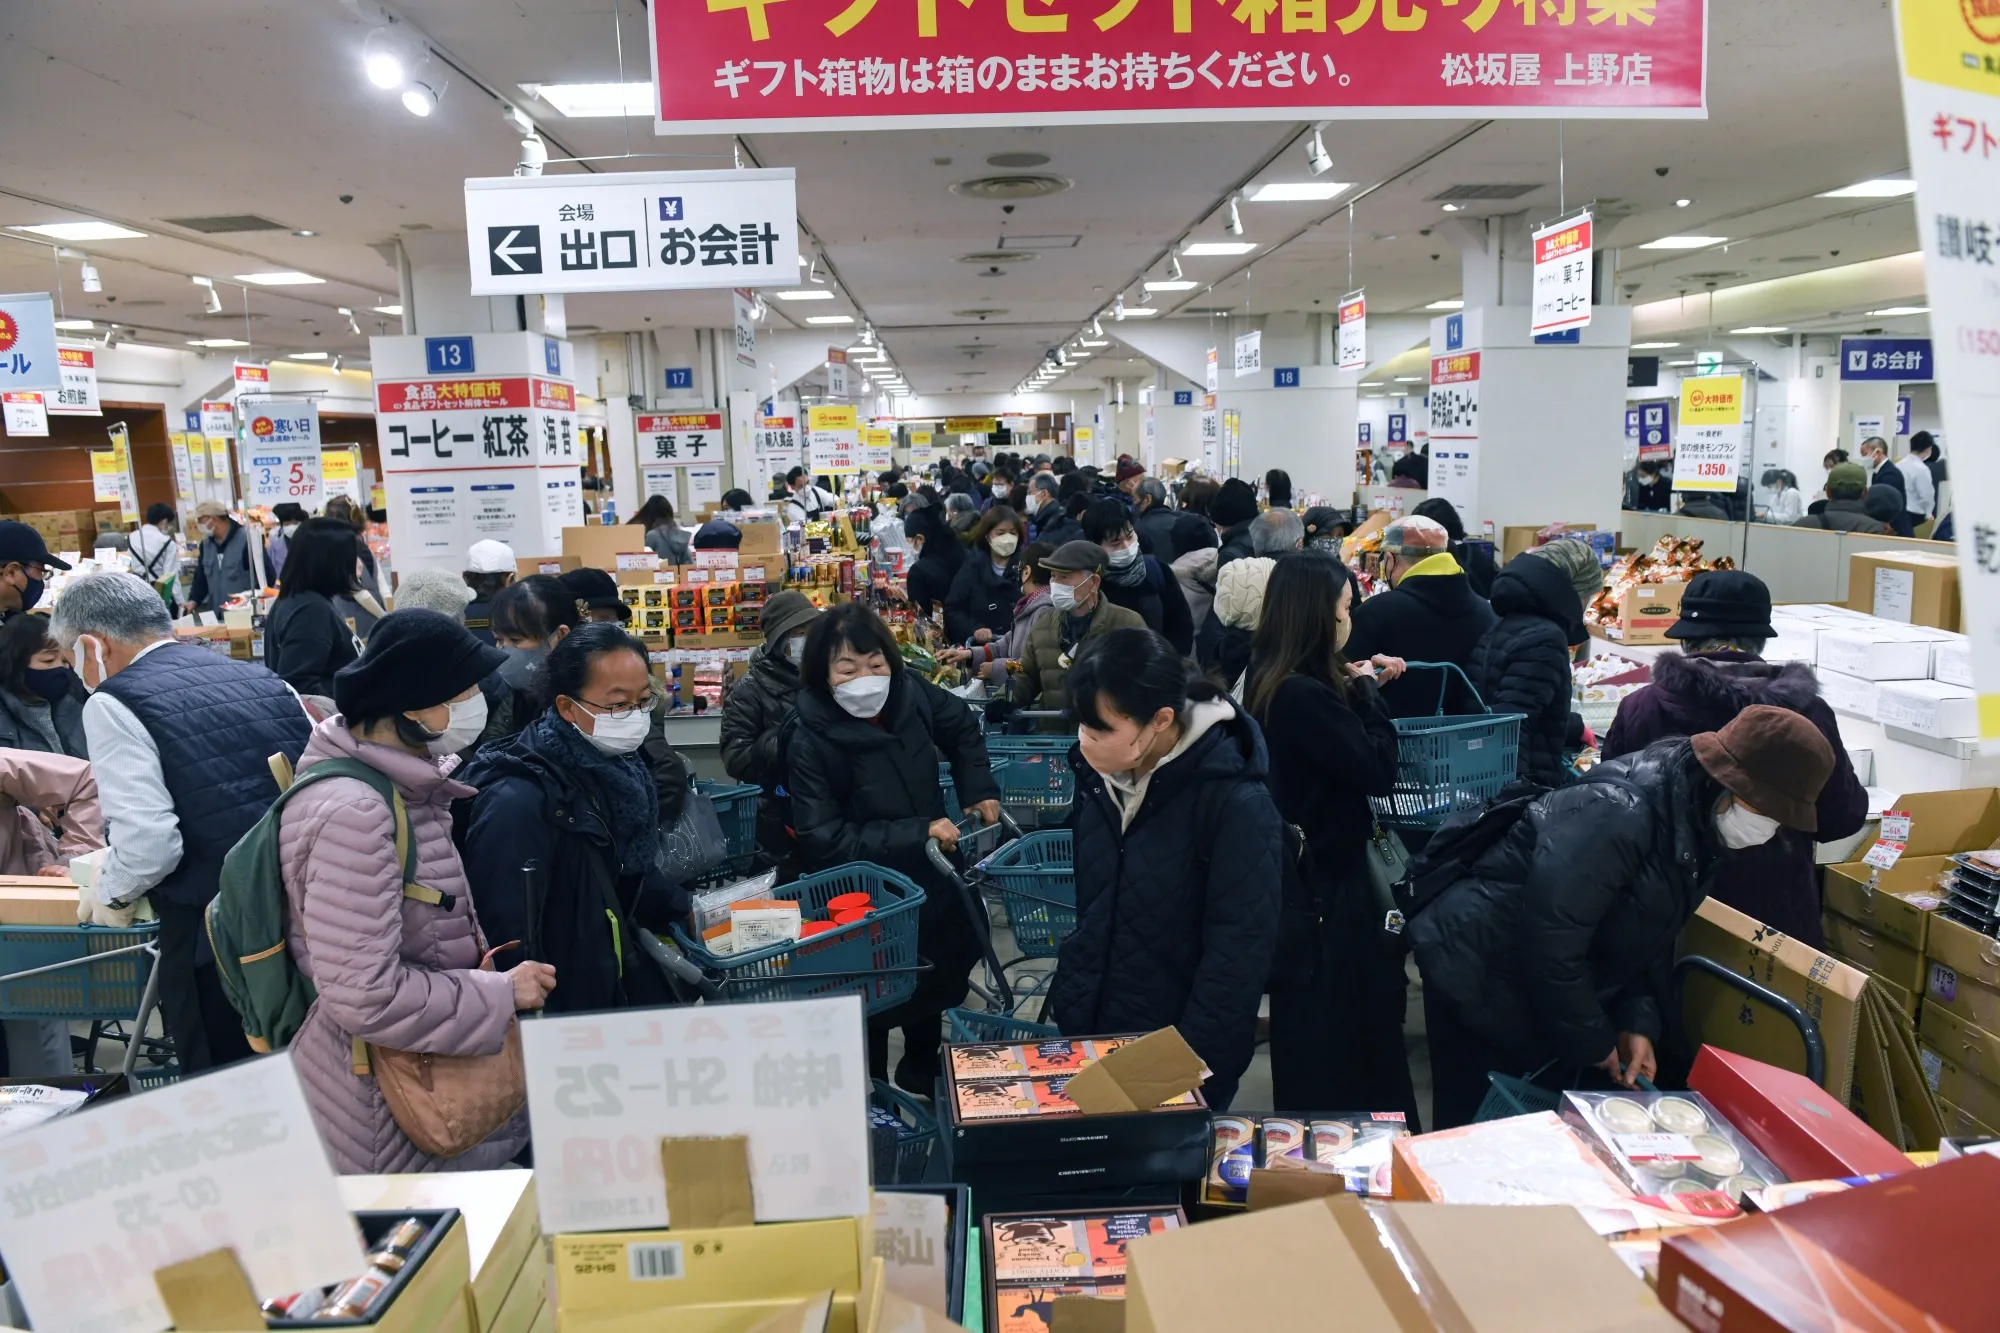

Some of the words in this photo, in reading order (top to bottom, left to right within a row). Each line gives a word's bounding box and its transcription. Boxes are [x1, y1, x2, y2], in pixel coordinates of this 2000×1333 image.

[713, 50, 1351, 98] ギフト箱物は箱のままお持ちください。
[1440, 53, 1541, 87] 松坂屋
[1554, 53, 1653, 87] 上野店
[558, 203, 595, 222] 会場
[560, 228, 638, 271] 出口
[660, 222, 779, 267] お会計
[1563, 261, 1584, 285] 菓子
[1556, 292, 1585, 313] コーヒー
[1449, 322, 1459, 343] 14
[438, 344, 462, 366] 13
[1872, 351, 1923, 370] お会計
[672, 372, 685, 385] 17
[1280, 371, 1293, 384] 18
[404, 381, 502, 401] 食品大特価市
[1178, 394, 1188, 403] 22
[1704, 394, 1733, 404] 大特価市
[1454, 389, 1478, 427] コーヒー
[274, 418, 311, 434] 寒い日
[542, 414, 572, 457] 海苔
[388, 418, 475, 459] コーヒー
[482, 414, 530, 459] 紅茶
[654, 434, 708, 459] 菓子
[835, 443, 850, 451] 378
[830, 459, 850, 467] 1,080
[1697, 463, 1726, 476] 1,350
[288, 485, 316, 496] OFF
